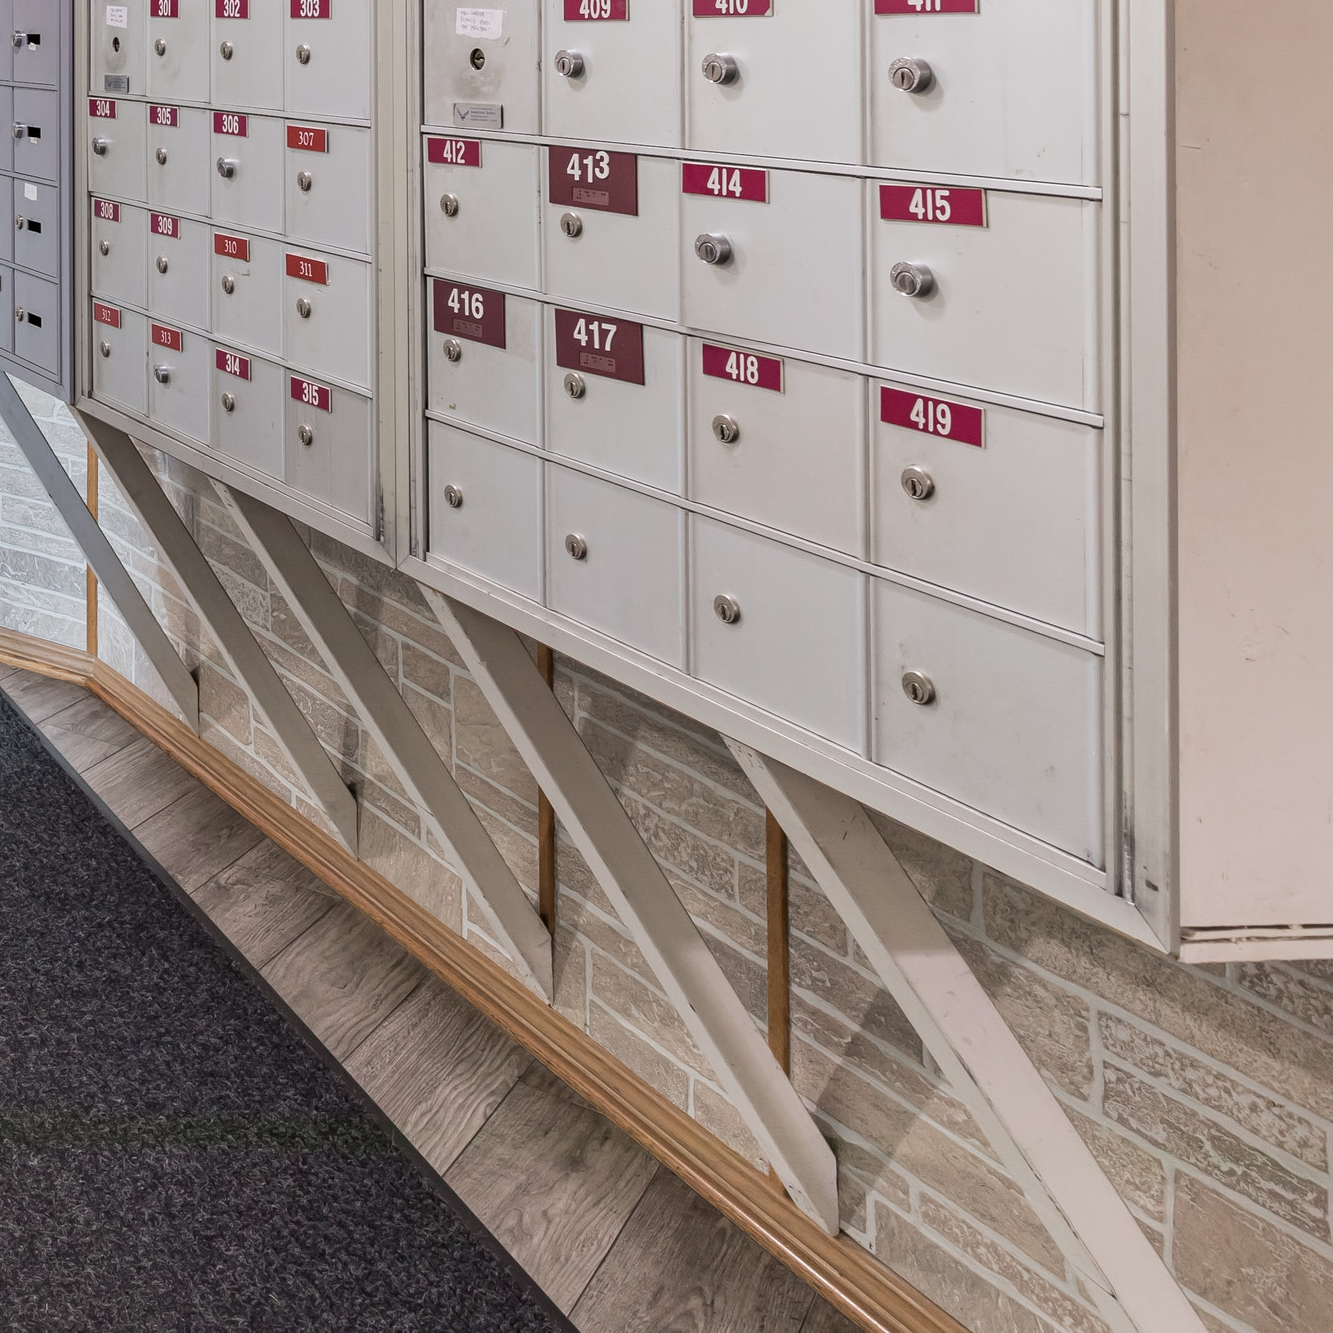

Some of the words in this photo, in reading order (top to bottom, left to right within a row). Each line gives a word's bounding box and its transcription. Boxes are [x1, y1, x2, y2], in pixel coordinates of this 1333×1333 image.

[224, 0, 240, 17] 302
[96, 100, 110, 117] 304
[156, 107, 171, 125] 305
[222, 115, 238, 133] 306
[299, 131, 314, 146] 307
[443, 140, 465, 163] 412
[567, 151, 609, 183] 413
[707, 168, 742, 197] 414
[101, 202, 113, 219] 308
[909, 189, 950, 221] 415
[158, 216, 172, 234] 309
[225, 240, 237, 254] 310
[300, 261, 312, 276] 311
[448, 288, 483, 319] 416
[102, 309, 110, 321] 312
[161, 331, 171, 344] 313
[574, 319, 616, 351] 417
[226, 354, 240, 376] 314
[726, 352, 758, 383] 418
[302, 383, 319, 405] 315
[910, 398, 951, 435] 419
